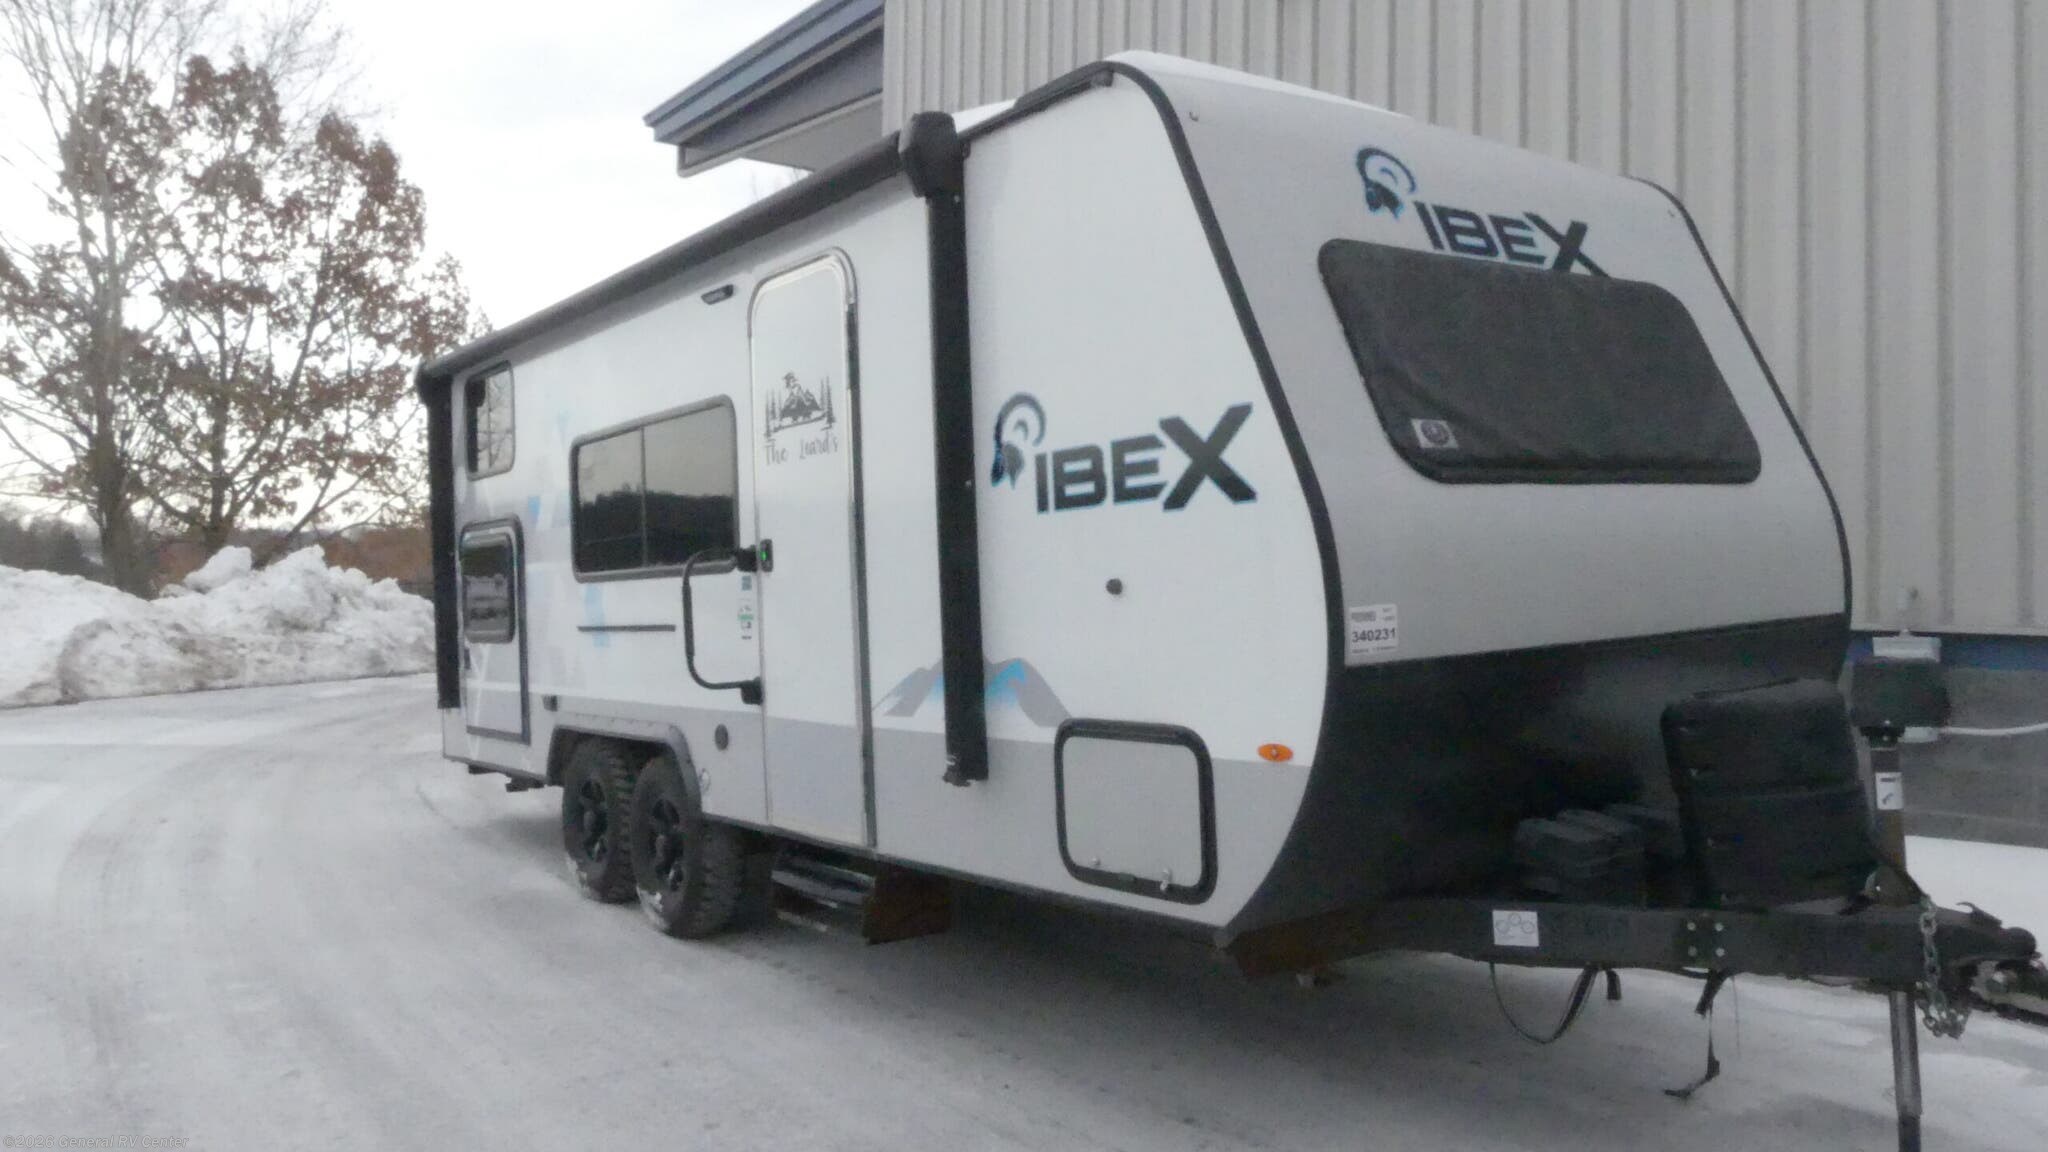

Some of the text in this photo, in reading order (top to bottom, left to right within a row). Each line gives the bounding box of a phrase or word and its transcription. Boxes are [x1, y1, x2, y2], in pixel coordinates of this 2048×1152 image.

[1413, 201, 1610, 278] IBEX
[764, 438, 789, 465] The
[1035, 402, 1257, 514] IBEX
[1351, 627, 1396, 643] 340231
